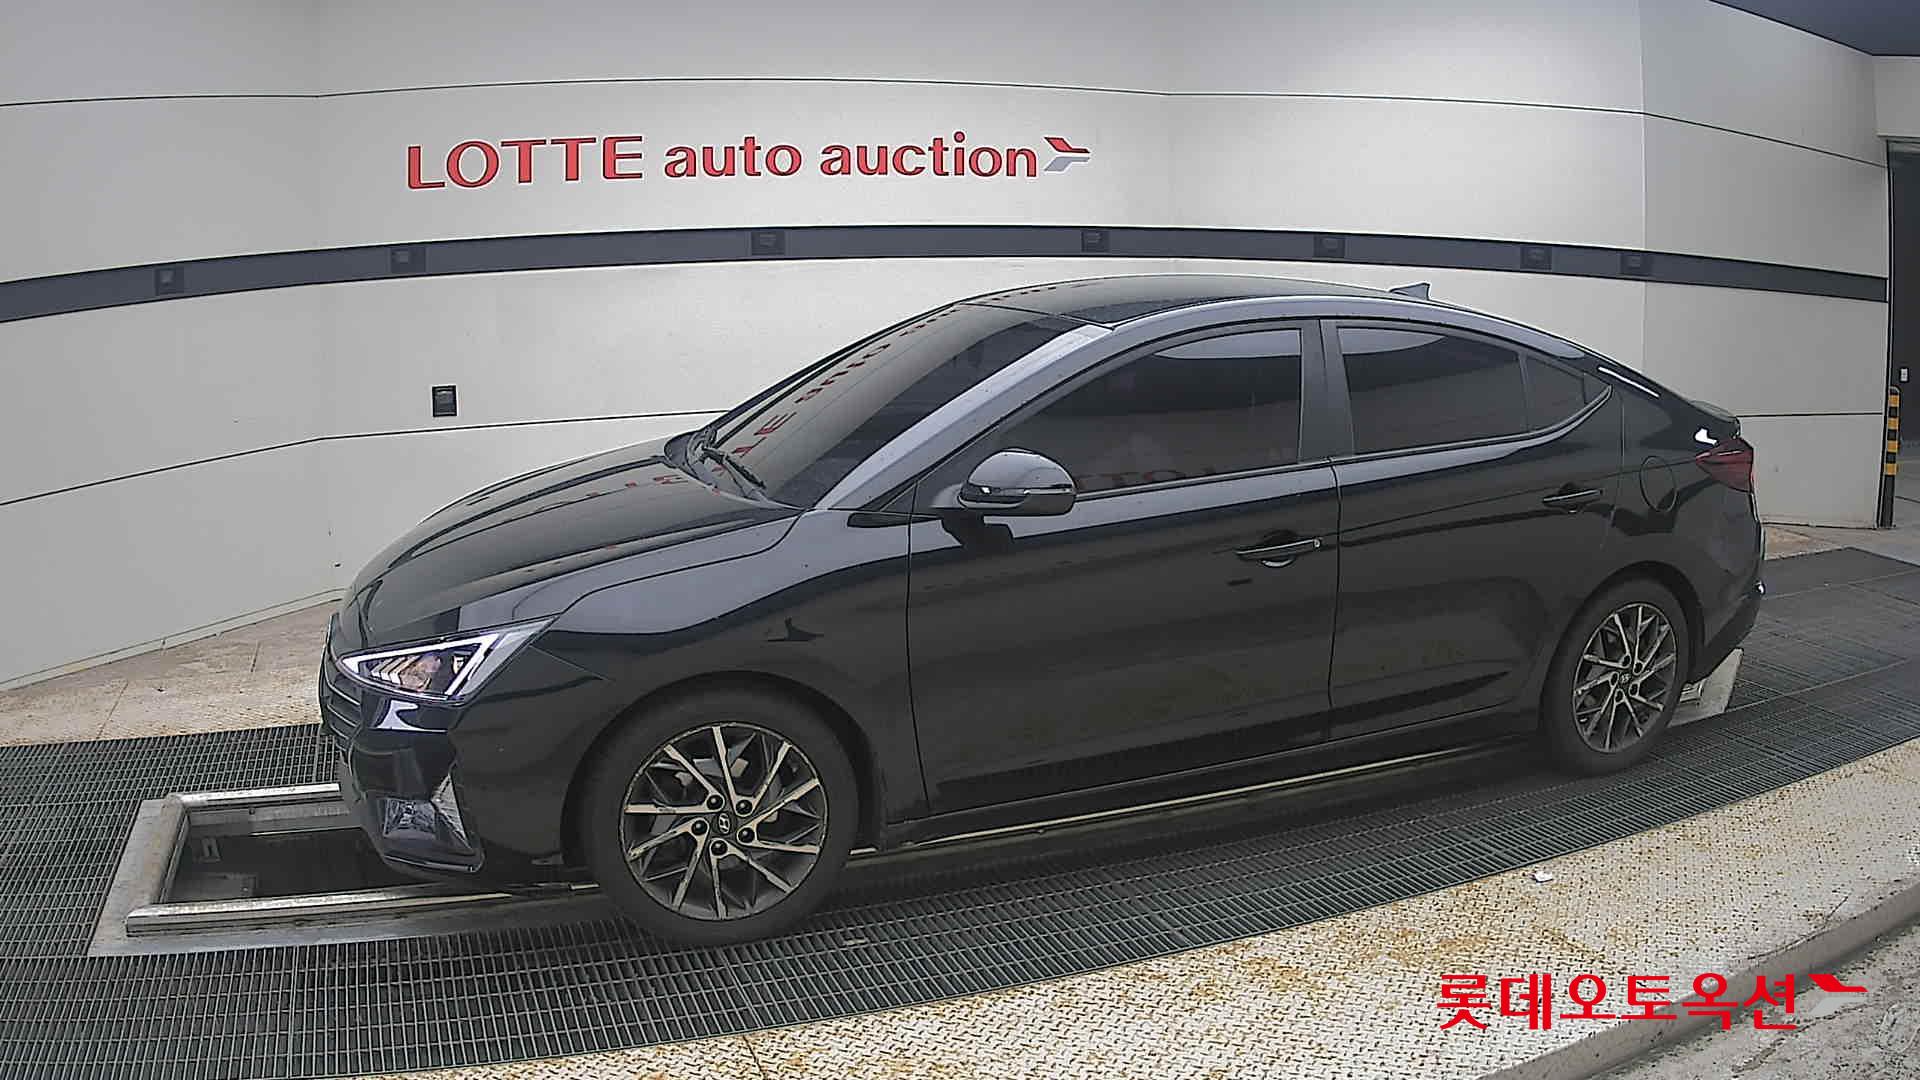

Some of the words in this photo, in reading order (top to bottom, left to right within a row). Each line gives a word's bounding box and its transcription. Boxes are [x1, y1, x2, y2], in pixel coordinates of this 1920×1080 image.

[407, 135, 642, 190] LOTTE
[664, 136, 801, 177] auto
[820, 131, 1037, 177] auction
